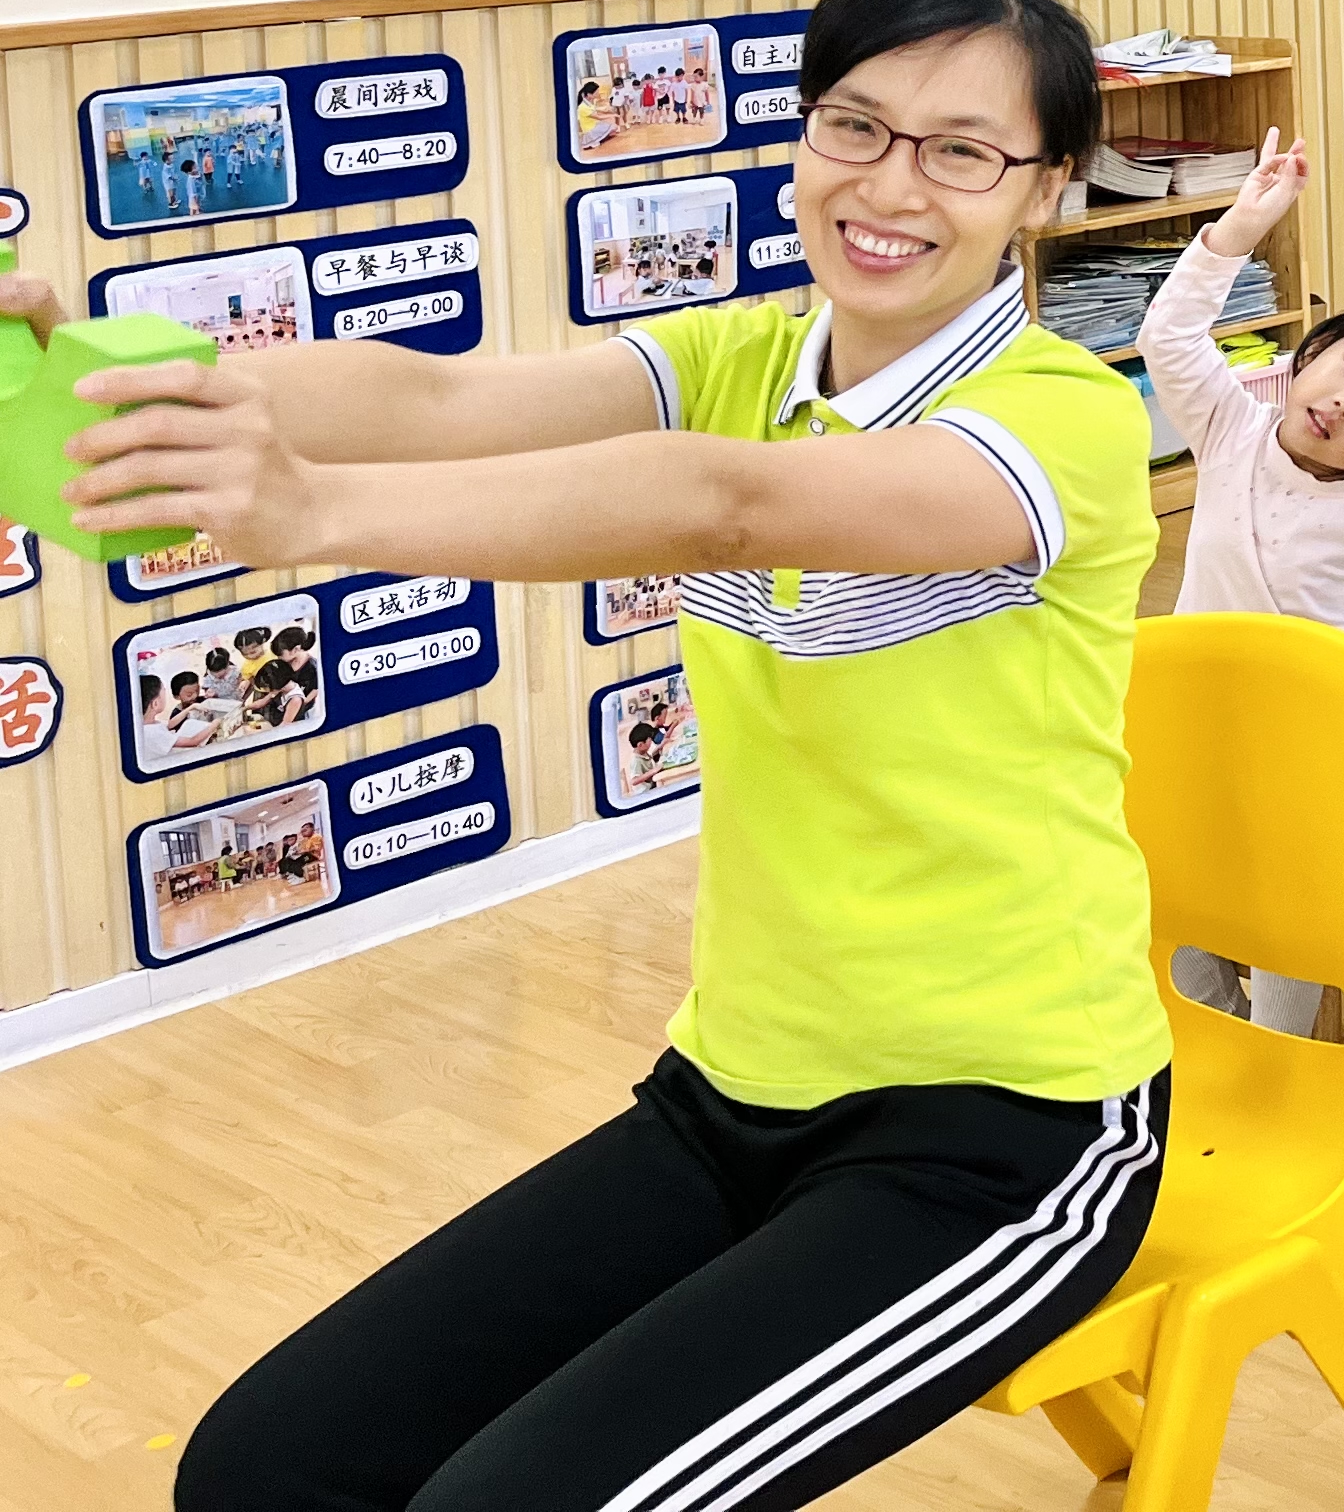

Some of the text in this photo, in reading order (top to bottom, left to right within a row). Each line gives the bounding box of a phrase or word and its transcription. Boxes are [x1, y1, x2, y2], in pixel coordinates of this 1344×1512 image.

[326, 78, 437, 113] 晨间游戏
[325, 241, 467, 285] 早餐与早谈
[351, 576, 457, 625] 区域活动
[360, 753, 465, 804] 小儿按摩
